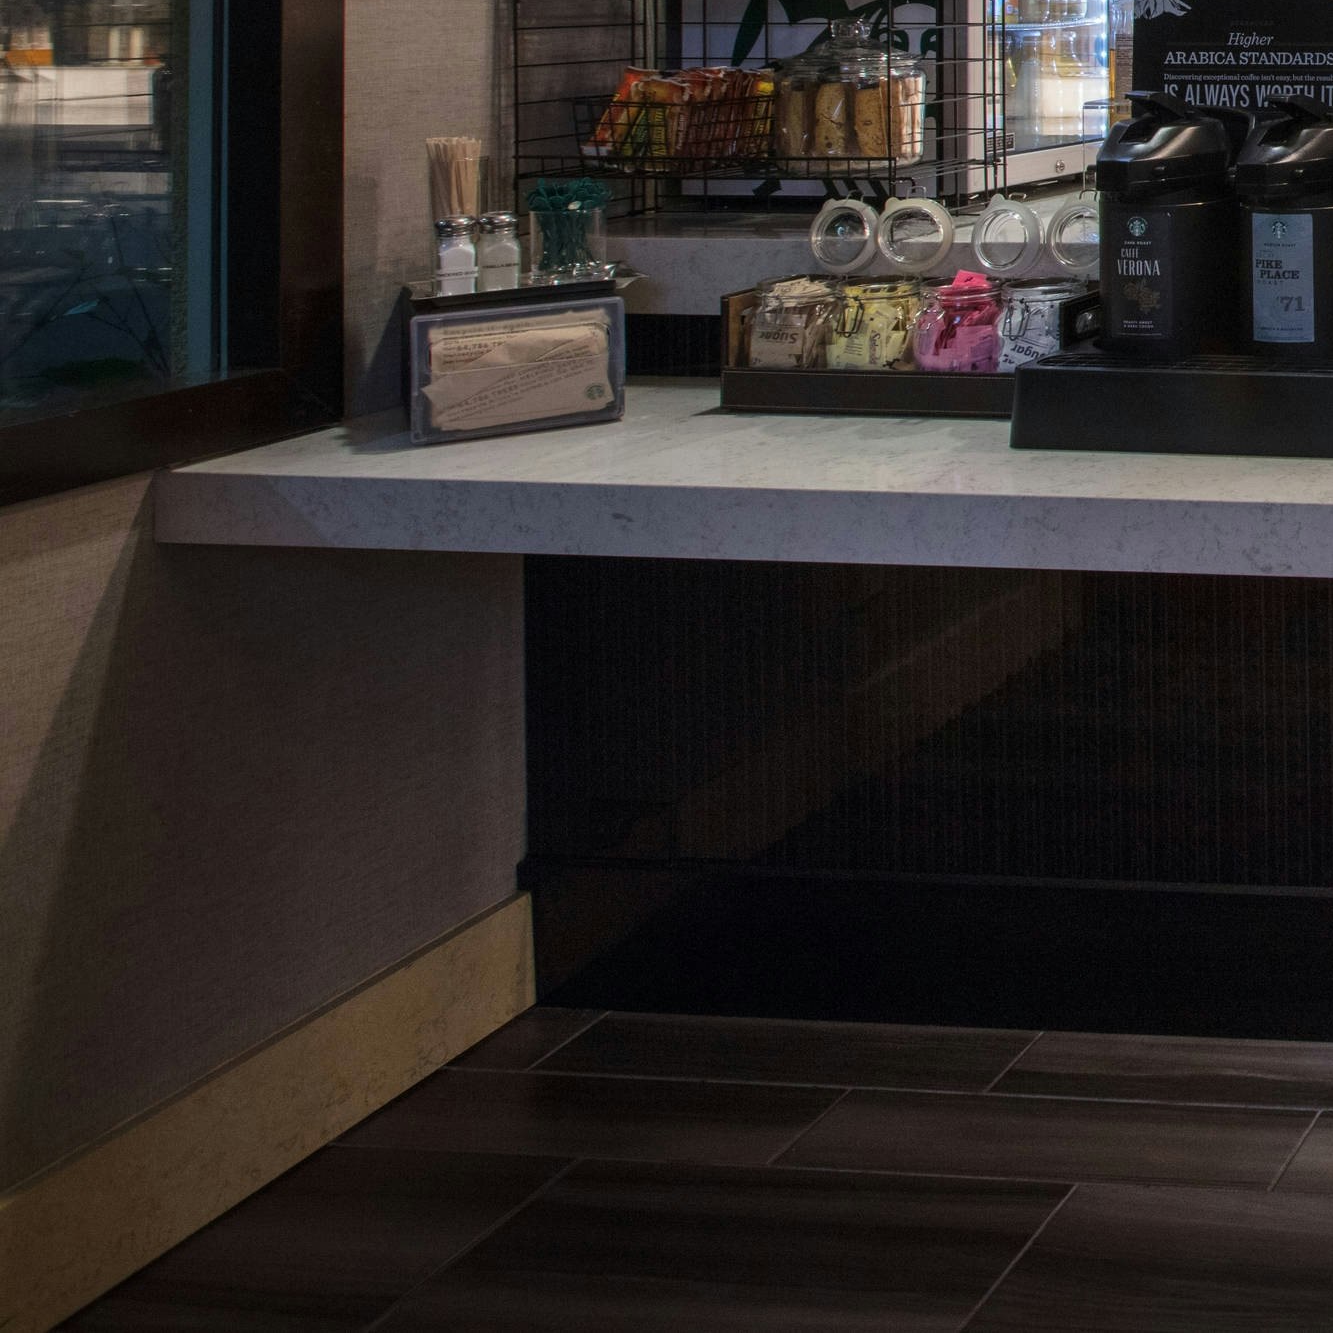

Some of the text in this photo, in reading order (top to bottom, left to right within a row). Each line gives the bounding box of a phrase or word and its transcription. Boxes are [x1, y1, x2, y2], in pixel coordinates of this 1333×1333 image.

[1226, 32, 1275, 49] Higher
[1164, 51, 1237, 65] ARABICA
[1164, 73, 1202, 82] Discovering
[1202, 73, 1240, 82] exceptional
[1241, 74, 1259, 82] coffee
[1293, 74, 1303, 82] but
[1304, 74, 1315, 82] the
[1185, 84, 1250, 107] ALWAYS
[1118, 259, 1161, 276] VERONA
[1256, 258, 1282, 269] PIKE
[1260, 270, 1300, 280] PLACE
[758, 330, 800, 345] Sugar
